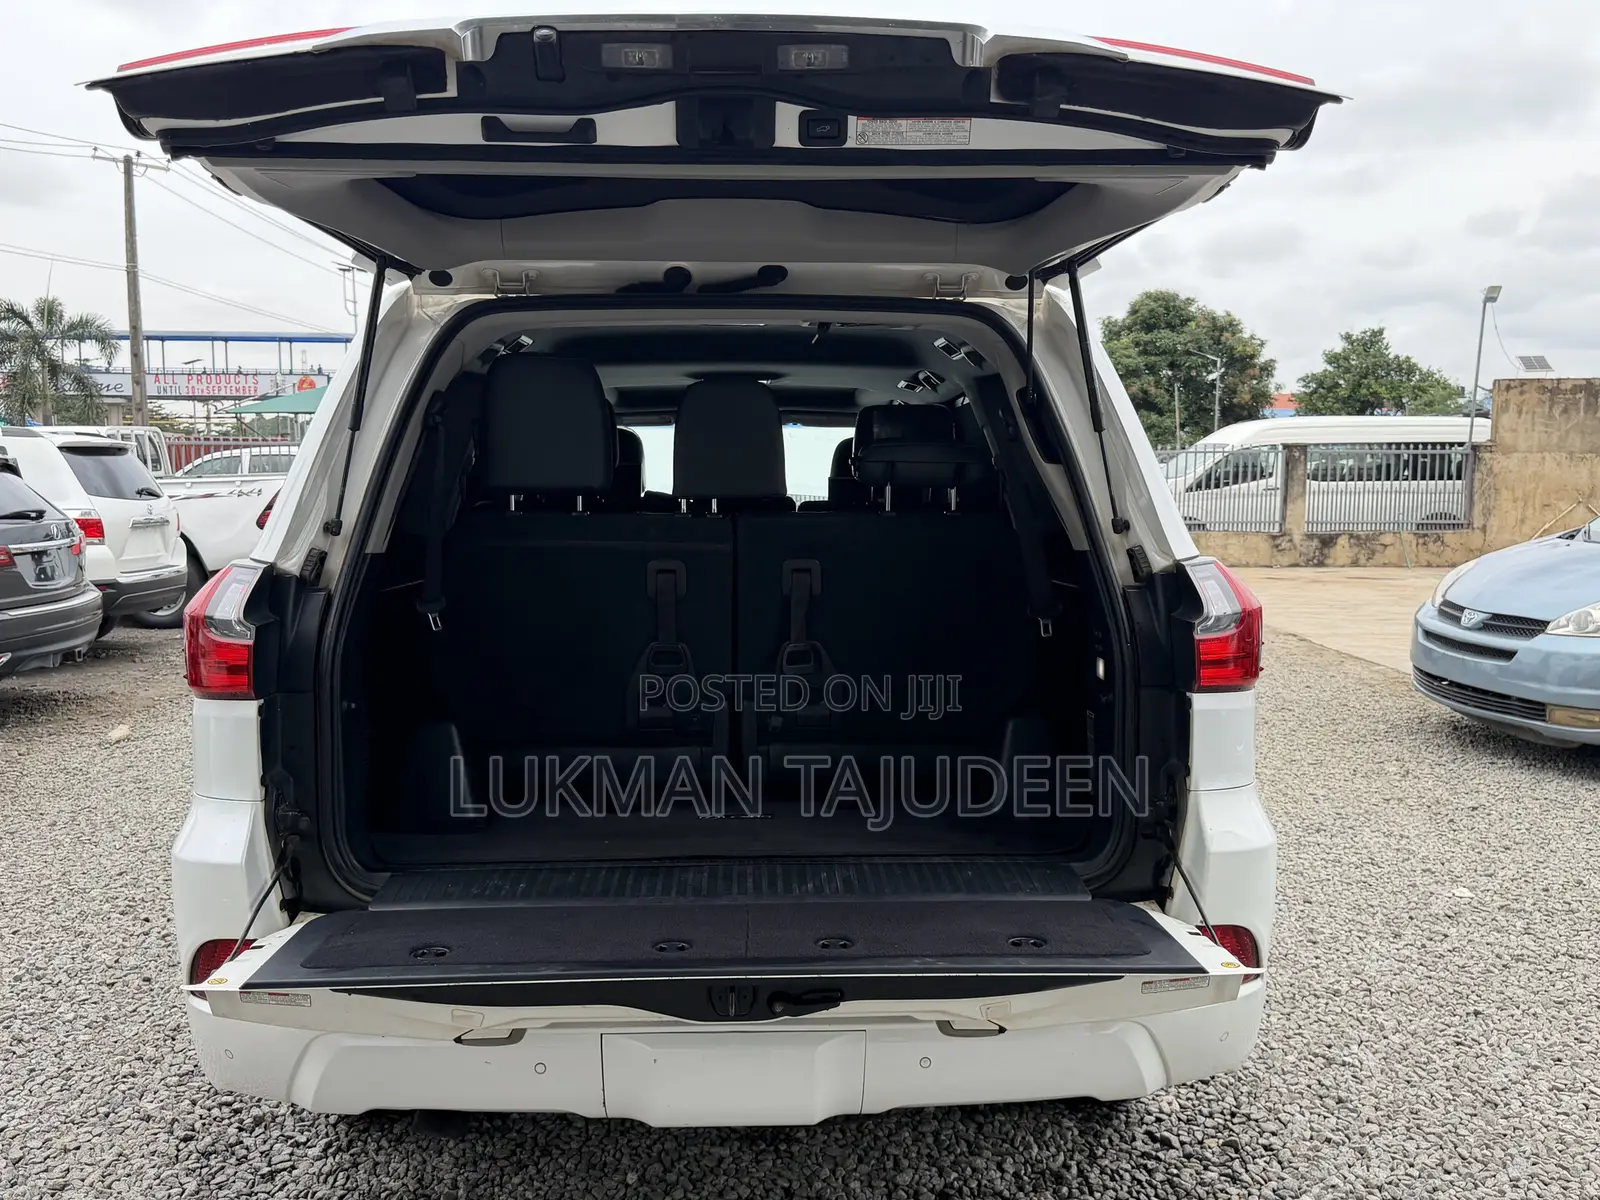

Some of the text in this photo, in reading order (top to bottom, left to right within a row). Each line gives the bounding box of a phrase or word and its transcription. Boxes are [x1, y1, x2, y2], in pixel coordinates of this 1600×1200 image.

[154, 374, 260, 385] ALL PRODUCTS
[156, 386, 182, 395] UNTIL
[206, 386, 258, 395] SEPTEMBER
